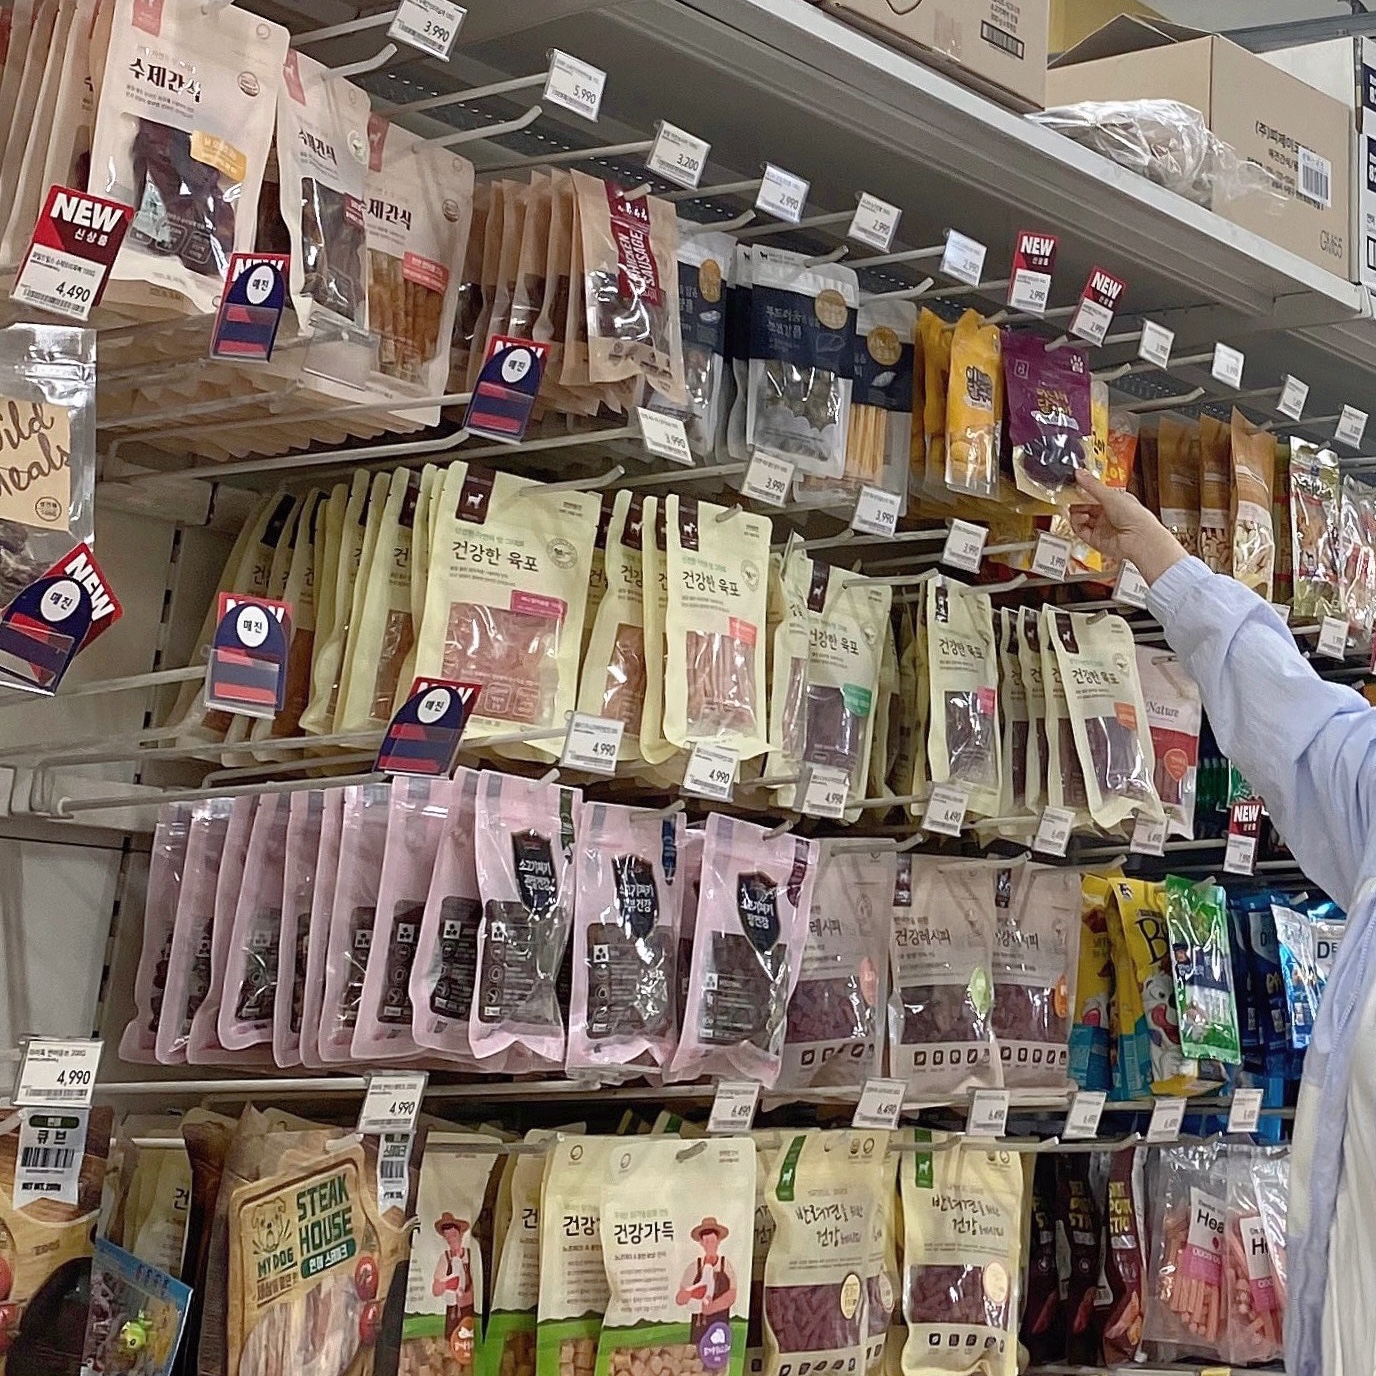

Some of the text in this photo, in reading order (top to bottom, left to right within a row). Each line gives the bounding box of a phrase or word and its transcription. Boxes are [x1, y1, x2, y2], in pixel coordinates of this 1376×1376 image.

[423, 20, 450, 42] 3,990
[676, 152, 700, 171] 3,200
[50, 192, 124, 233] NEW
[74, 228, 109, 247] 신상품
[1020, 236, 1054, 257] NEW
[56, 281, 91, 303] 4,490
[1091, 271, 1123, 299] NEW
[0, 400, 54, 448] ild
[451, 540, 539, 574] 건강한 육포
[682, 571, 742, 597] 건강한 육포
[49, 592, 74, 612] 매진
[242, 618, 264, 635] 매진
[424, 698, 444, 712] 매진
[1147, 702, 1180, 718] Nature
[592, 740, 617, 756] 4,990
[708, 768, 731, 784] 4,990
[1233, 804, 1260, 823] NEW
[895, 928, 951, 947] 건강레시피
[57, 1069, 91, 1086] 4,990
[389, 1101, 415, 1116] 4,990
[38, 1130, 67, 1145] 큐브
[296, 1172, 350, 1223] STEAK
[299, 1205, 353, 1257] HOUSE
[613, 1221, 675, 1245] 건강가득
